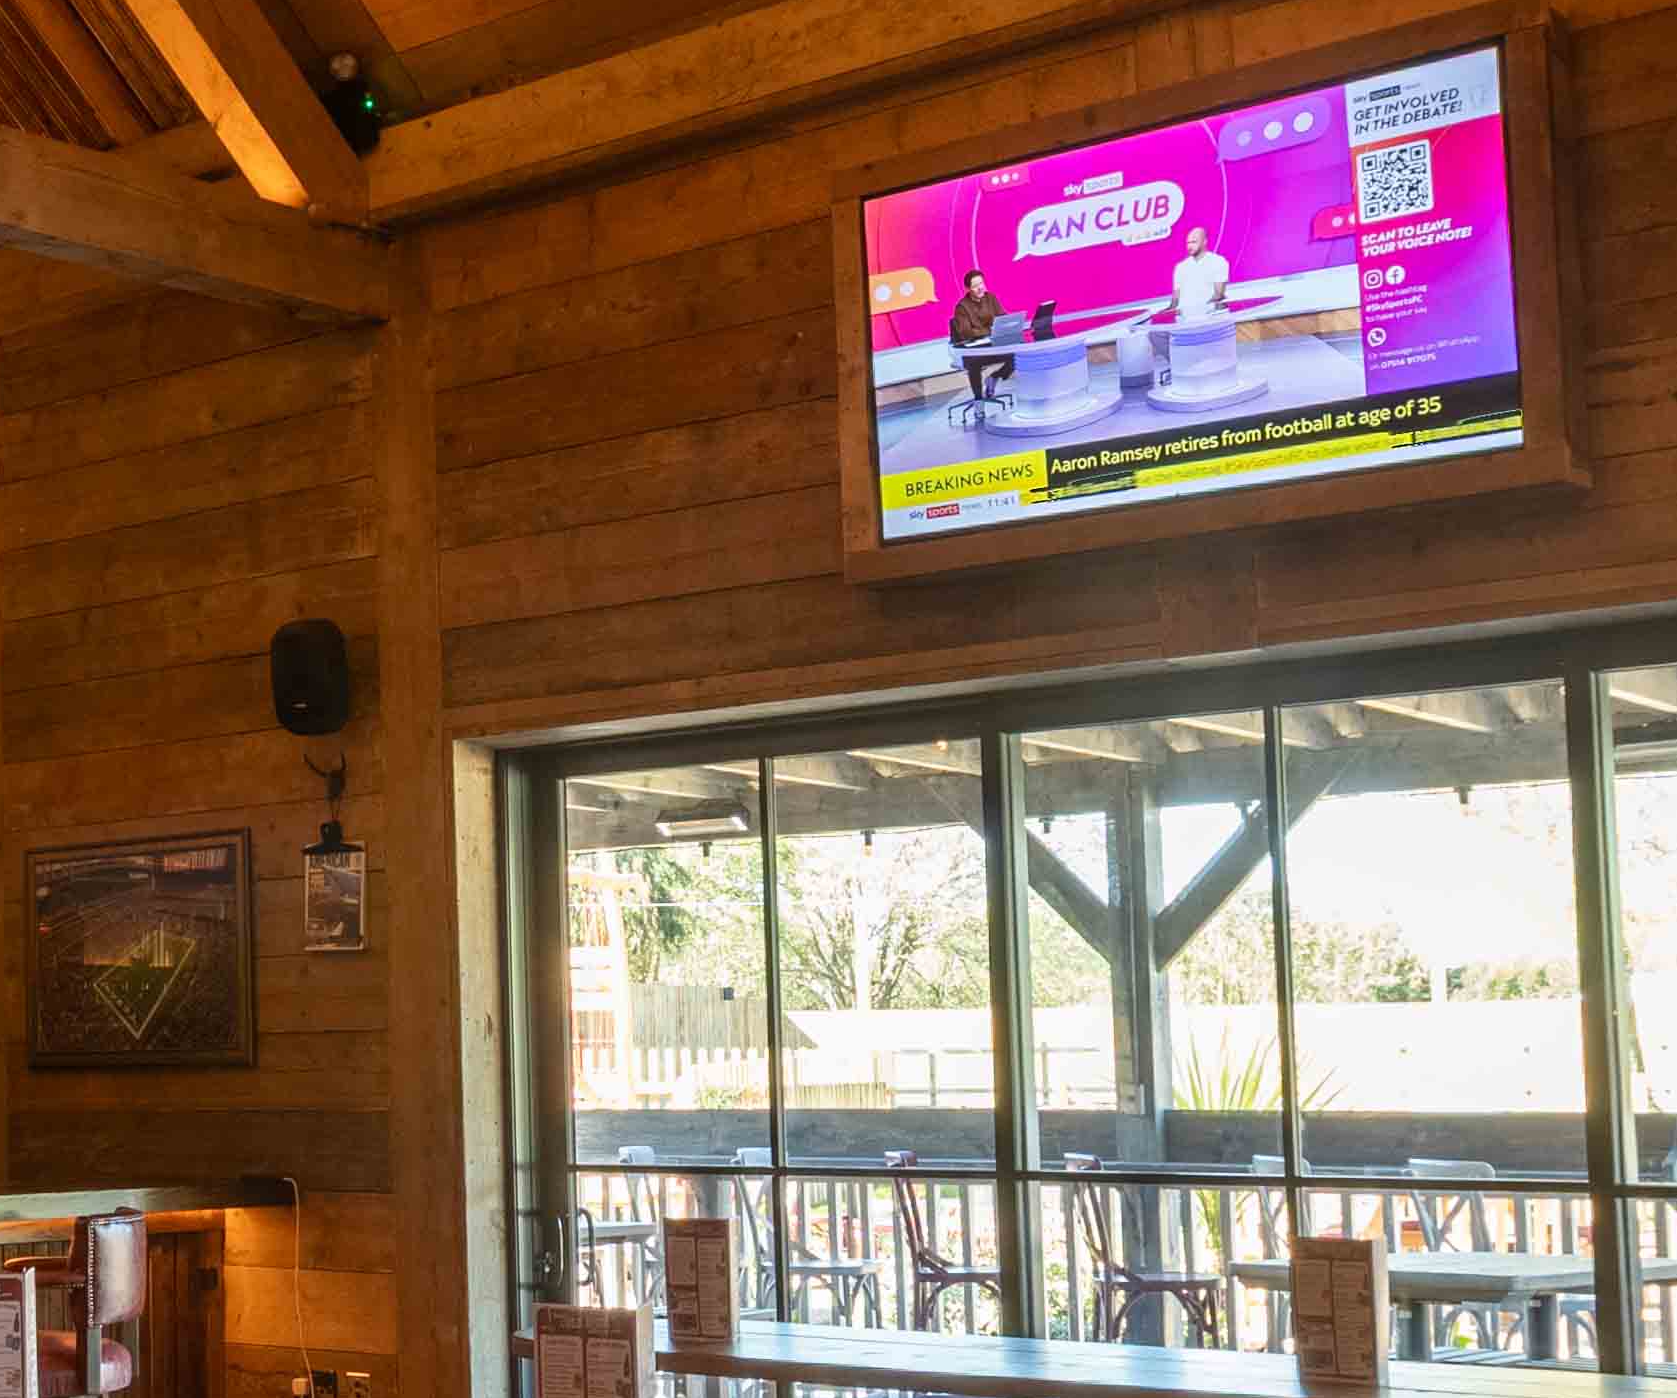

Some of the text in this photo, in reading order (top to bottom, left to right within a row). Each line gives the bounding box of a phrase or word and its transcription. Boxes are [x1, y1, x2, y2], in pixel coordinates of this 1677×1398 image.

[1354, 88, 1459, 122] GET INVOLVED
[1355, 100, 1462, 136] IN THE DEBATE!
[1063, 185, 1083, 197] sky
[1031, 212, 1086, 245] FAN
[1095, 195, 1169, 230] CLUB
[1361, 218, 1452, 246] SCAN TO LEAVE
[1363, 226, 1473, 257] YOUR VOICE NOTE!
[1051, 395, 1442, 474] Aaron Ramsey retires from football at age of 35
[905, 464, 1034, 497] BREAKING NEWS
[909, 510, 925, 521] sky
[928, 504, 959, 518] sports
